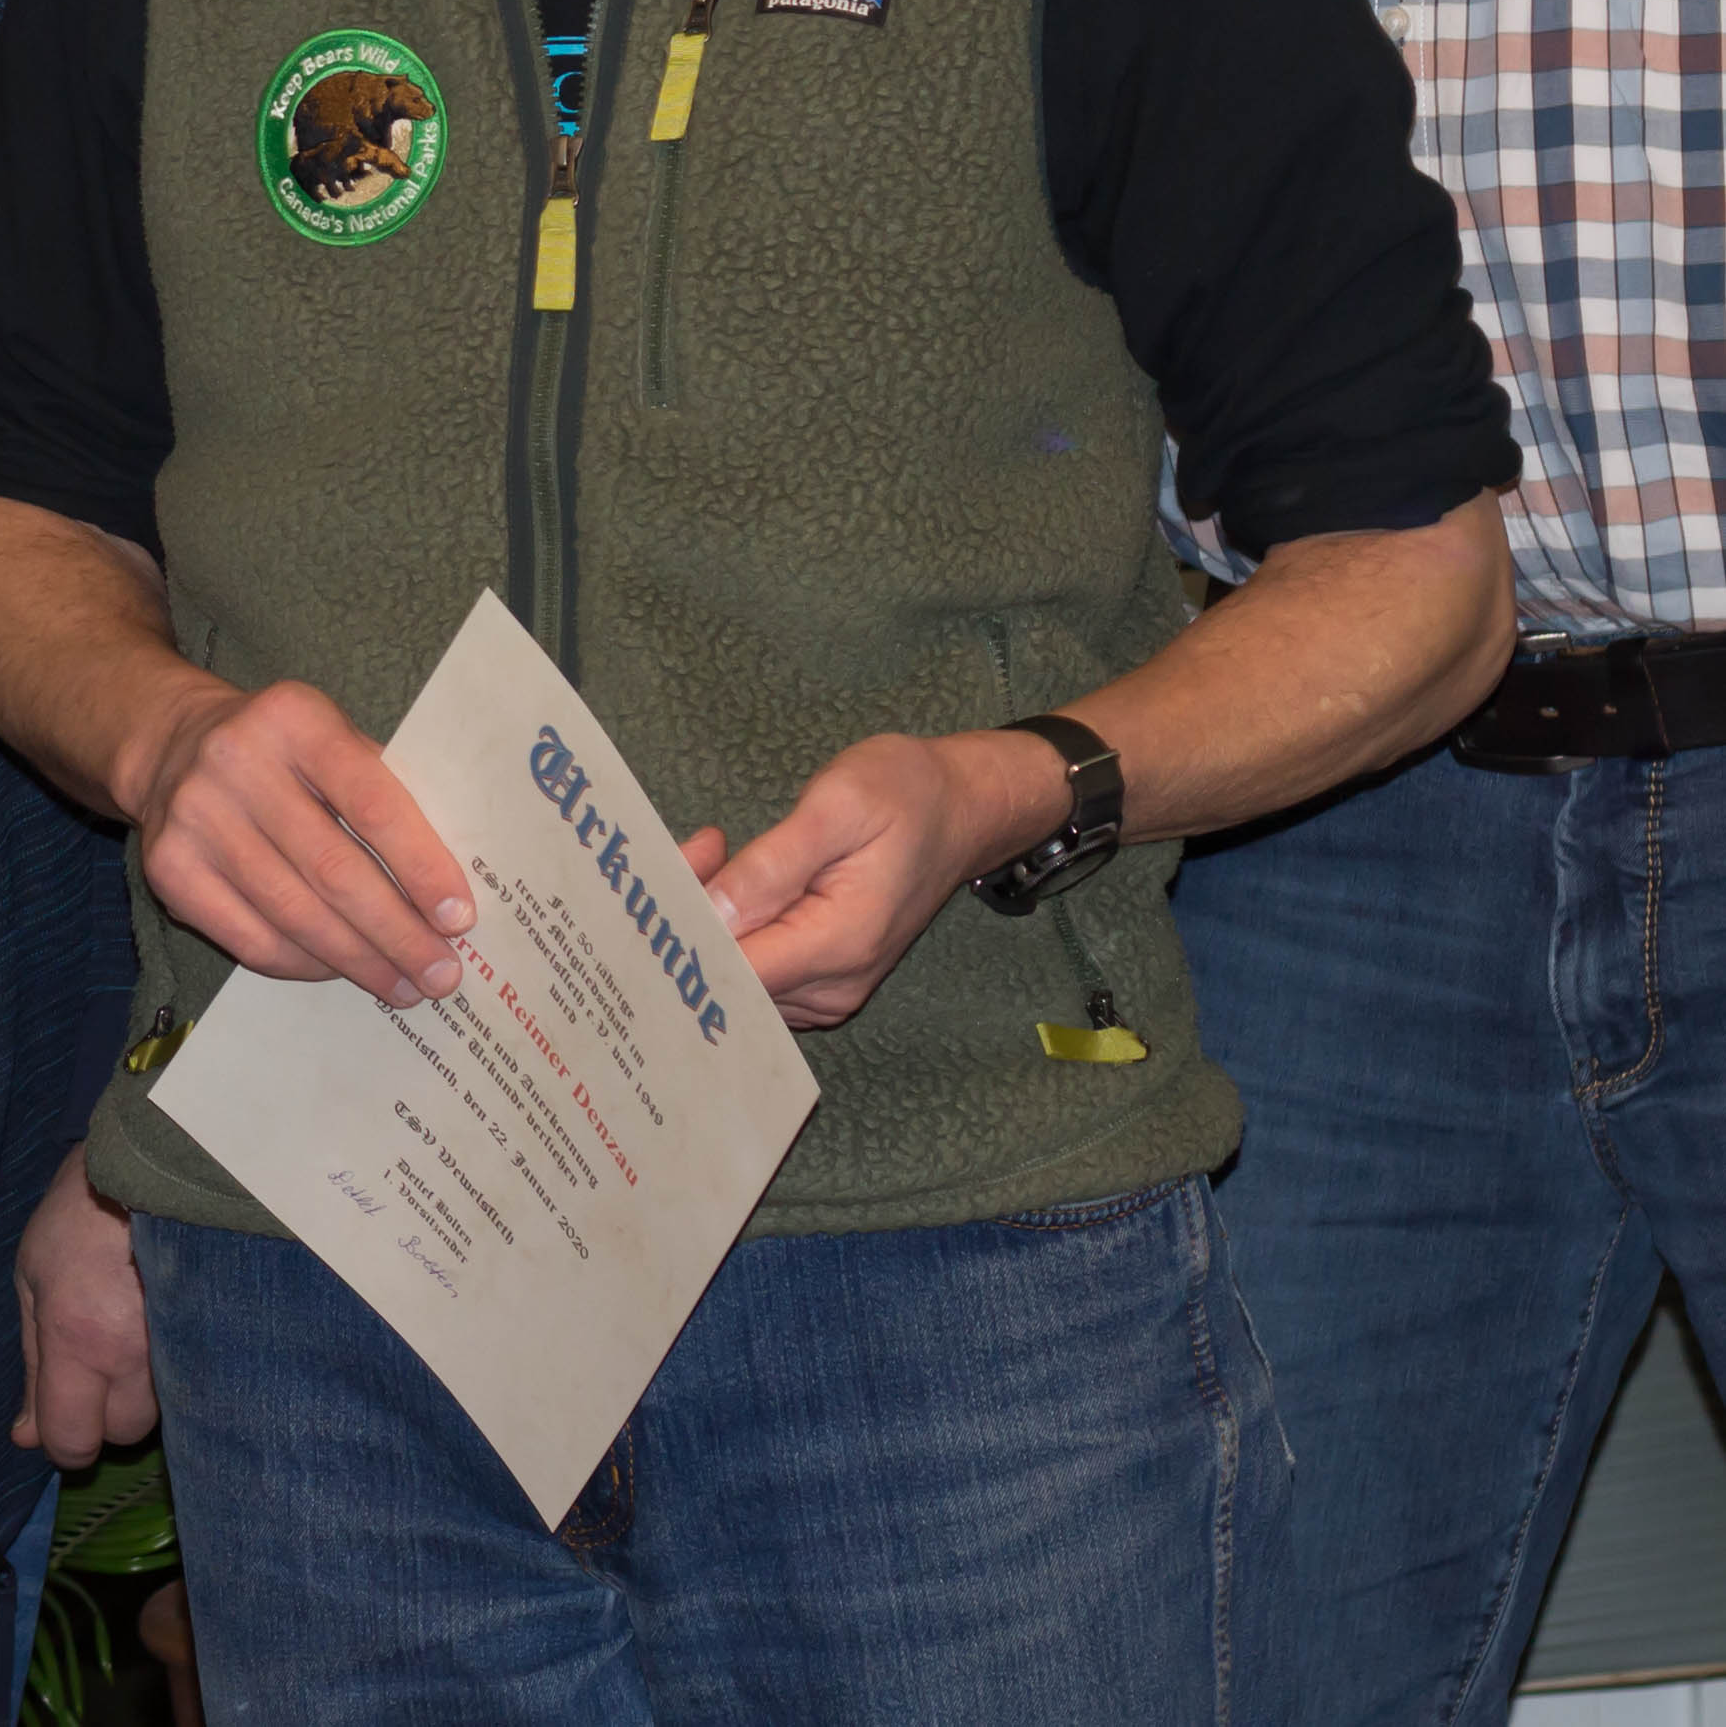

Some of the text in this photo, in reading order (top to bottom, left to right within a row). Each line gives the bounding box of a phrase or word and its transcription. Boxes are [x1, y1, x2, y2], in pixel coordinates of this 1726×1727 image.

[270, 42, 401, 120] Keep Bears Wild
[278, 121, 439, 234] Canada's National Parks
[529, 723, 728, 1047] Urkunde
[546, 894, 577, 931] Für
[471, 856, 513, 903] TSV
[514, 904, 586, 1008] Wewelsfleth
[611, 1045, 633, 1080] von
[635, 1081, 664, 1127] 1949
[515, 877, 646, 1069] treue Mitgliedschaft im
[549, 982, 577, 1025] wird
[430, 998, 578, 1189] diese Urkunde verliehen
[447, 936, 638, 1188] rrn Reimer Denzau
[452, 990, 600, 1190] Dank und Anerkennung
[394, 1098, 515, 1246] TSV Wewelsfleth
[435, 1198, 473, 1248] Bolten
[463, 1089, 487, 1123] den
[487, 1121, 508, 1153] 22.
[510, 1150, 558, 1214] Januar
[557, 1215, 589, 1261] 2020
